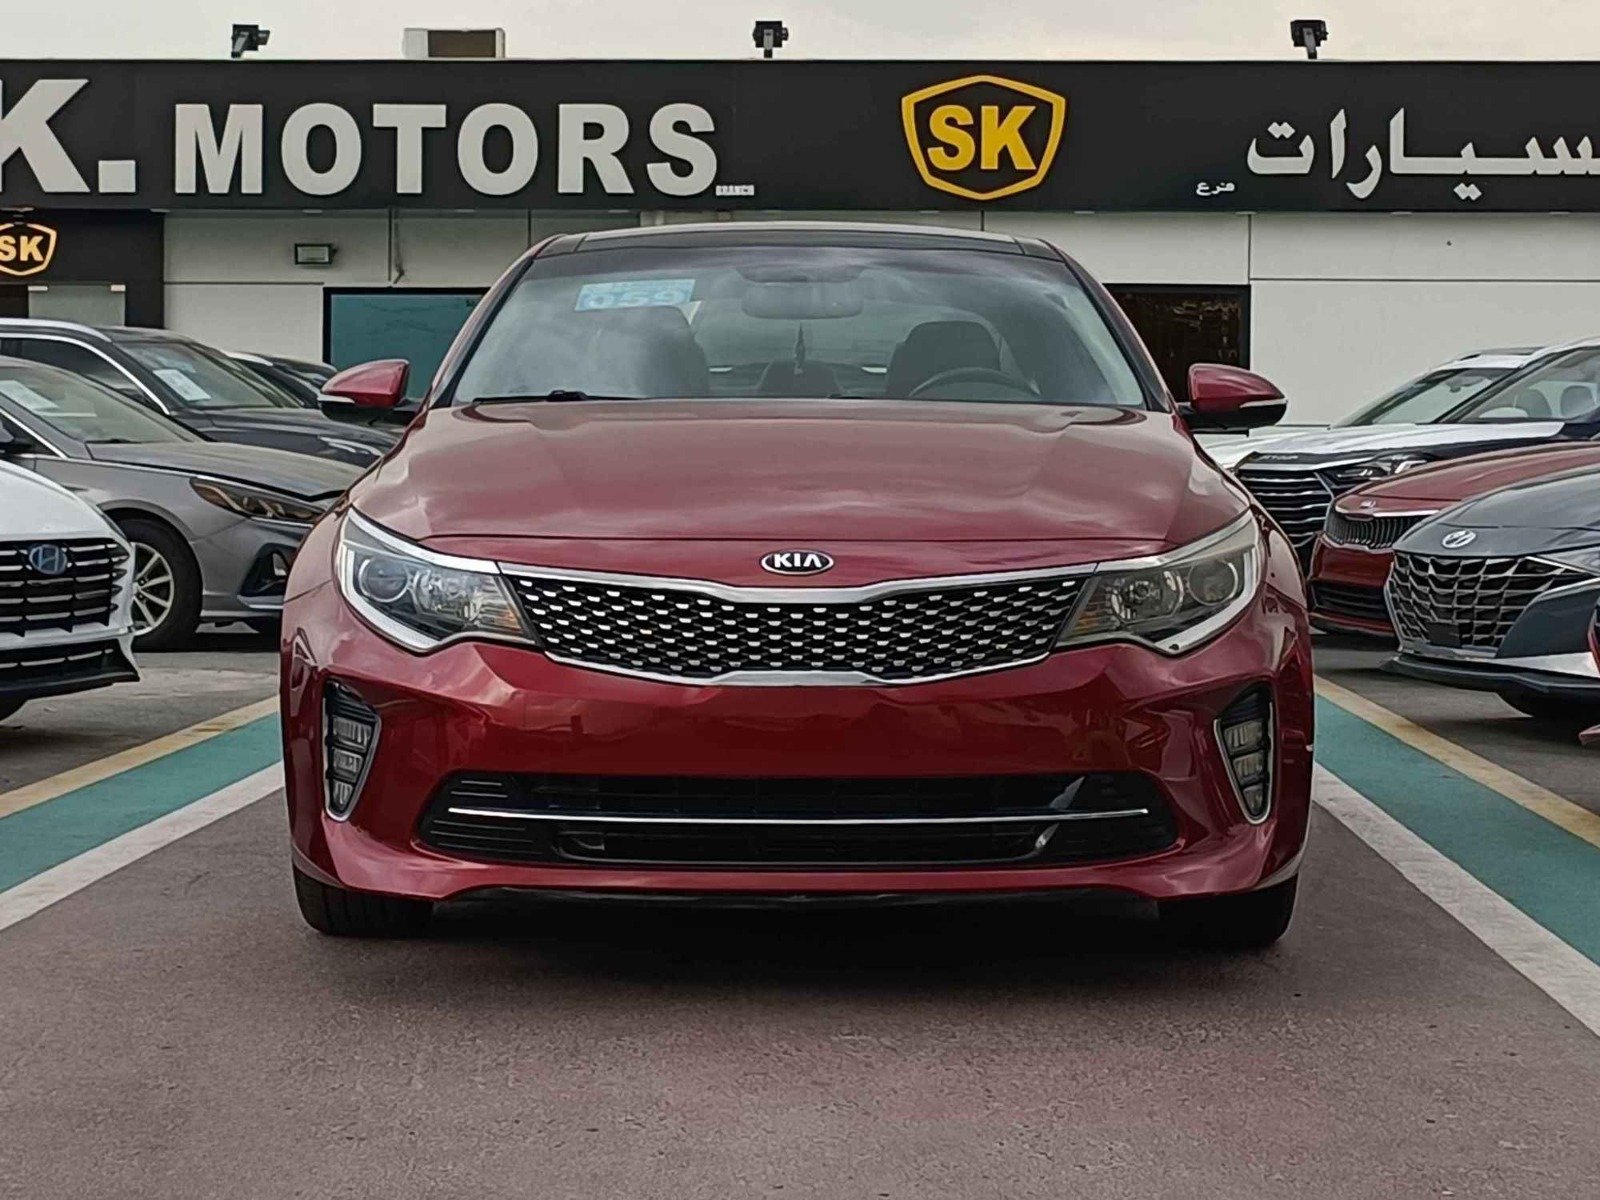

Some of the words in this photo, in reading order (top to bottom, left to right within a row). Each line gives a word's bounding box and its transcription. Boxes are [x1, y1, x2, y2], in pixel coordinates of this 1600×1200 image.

[174, 102, 717, 196] MOTORS
[927, 104, 1037, 171] SK
[1195, 181, 1235, 196] فرع
[0, 235, 45, 262] SK
[773, 552, 823, 568] KIA
